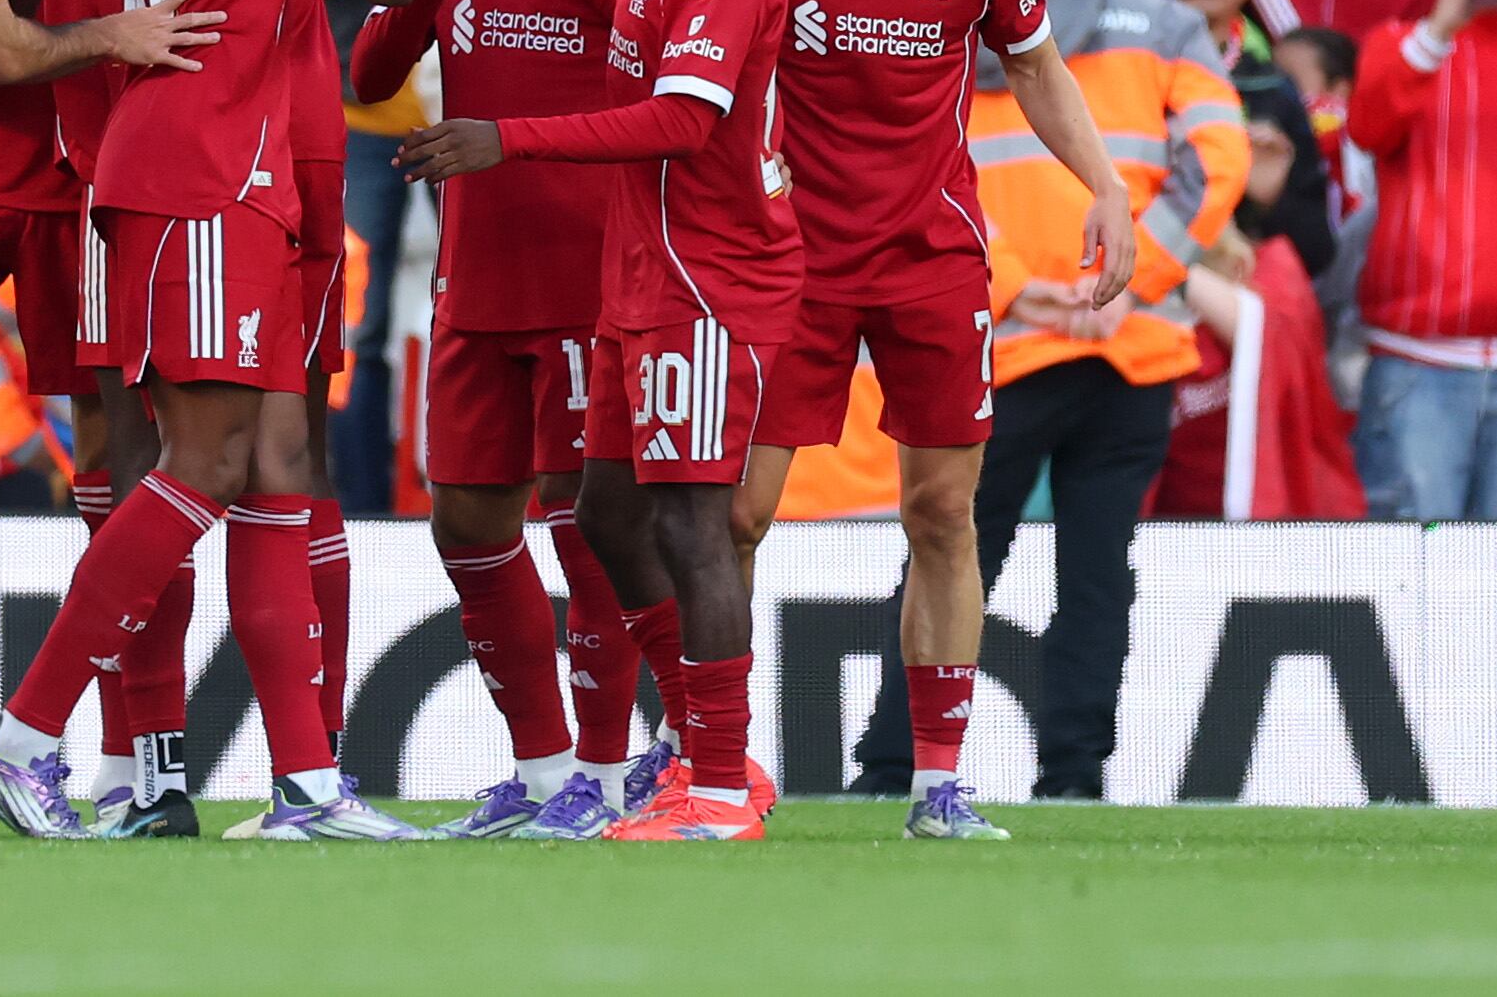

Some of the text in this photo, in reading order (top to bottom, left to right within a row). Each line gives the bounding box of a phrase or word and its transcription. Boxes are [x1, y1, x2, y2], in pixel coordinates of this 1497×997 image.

[482, 8, 579, 35] standard
[835, 13, 942, 39] standard
[480, 29, 584, 54] chartered
[835, 32, 944, 57] chartered
[634, 352, 691, 426] 30
[118, 614, 147, 634] LF
[467, 639, 495, 653] FC
